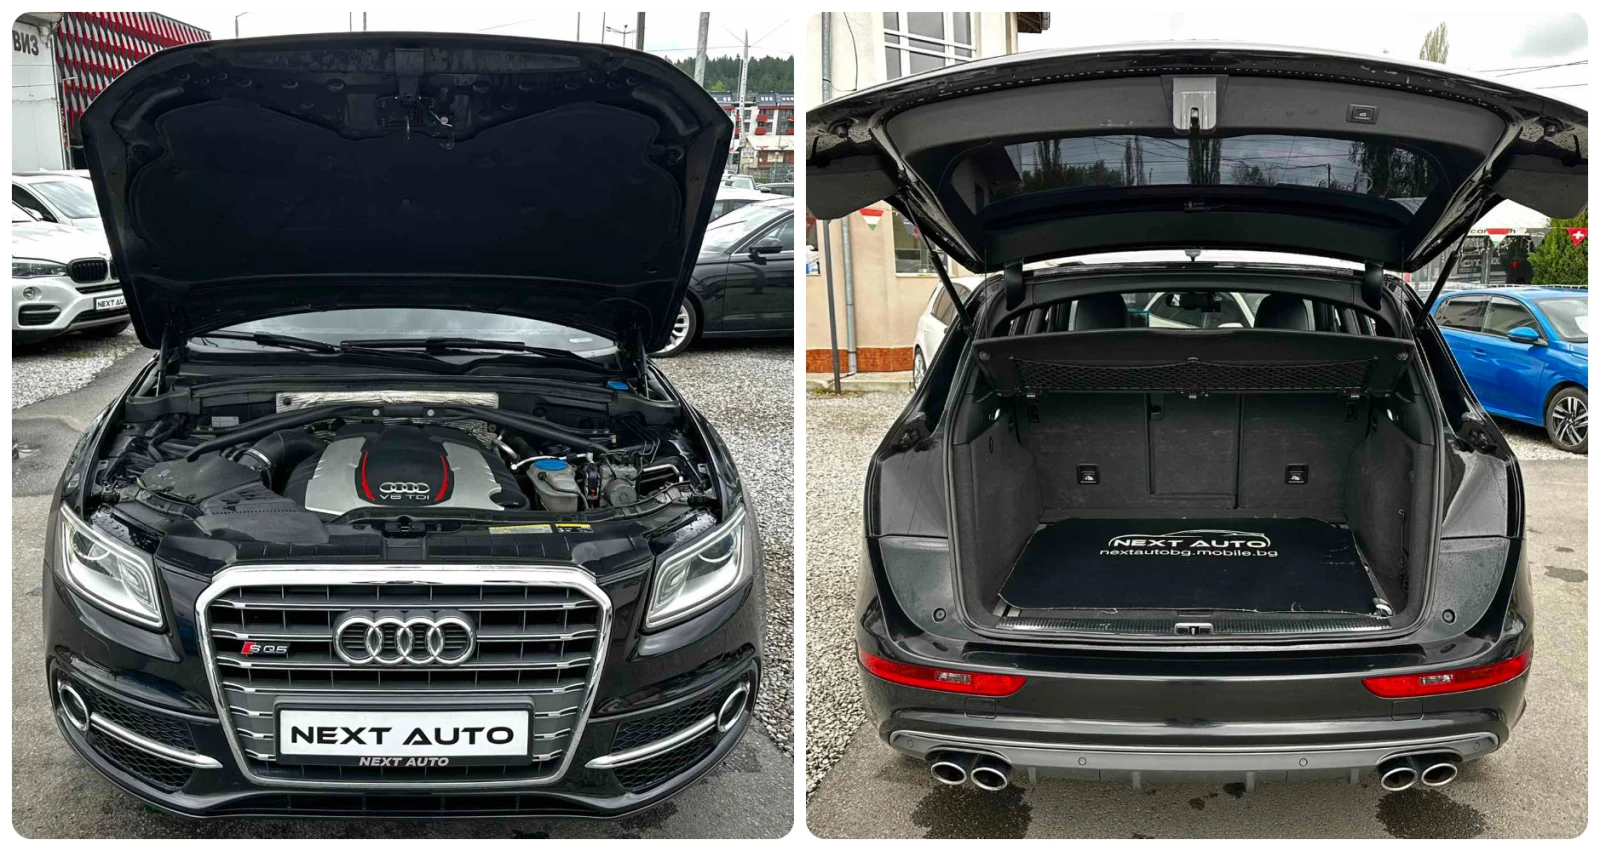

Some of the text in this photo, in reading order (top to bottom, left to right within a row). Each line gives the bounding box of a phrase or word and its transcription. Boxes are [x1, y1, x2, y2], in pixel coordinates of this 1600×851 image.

[97, 299, 115, 308] NEXT
[1113, 539, 1267, 548] NEXT AUTO
[1100, 549, 1279, 557] nextautobg.mobile.bg
[291, 725, 515, 746] NEXT AUTO
[359, 757, 450, 767] NEXT AUTO
